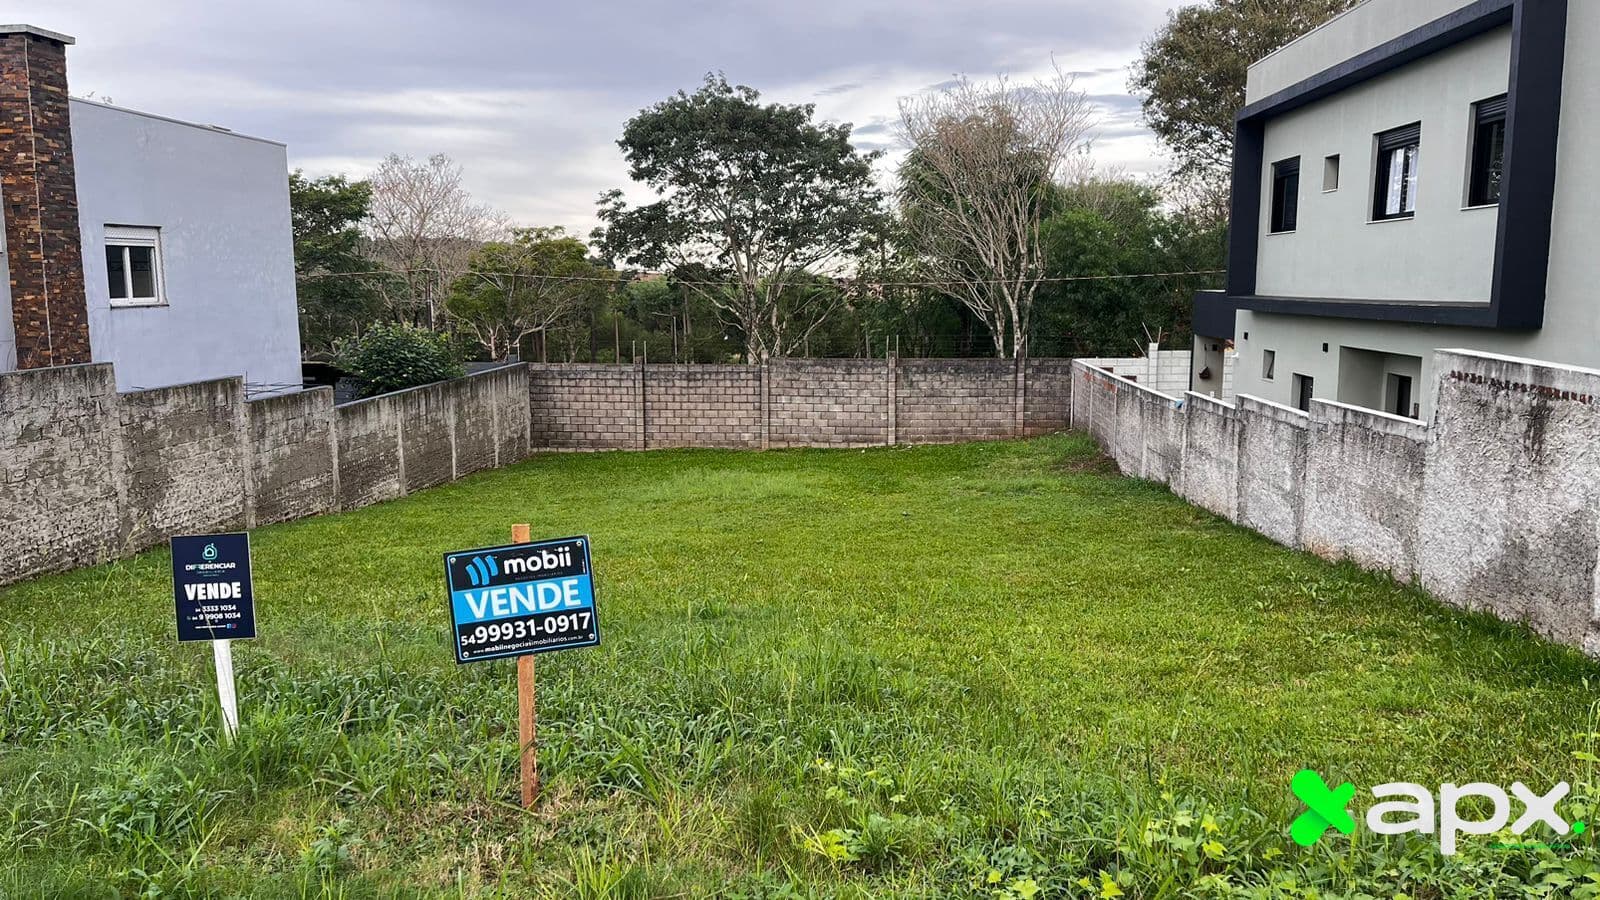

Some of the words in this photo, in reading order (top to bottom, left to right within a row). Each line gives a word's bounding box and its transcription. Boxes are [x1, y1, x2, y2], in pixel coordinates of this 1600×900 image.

[185, 562, 236, 571] DIFFERENCIAR
[503, 546, 572, 575] mobii
[184, 582, 242, 601] VENDE
[464, 579, 582, 619] VENDE
